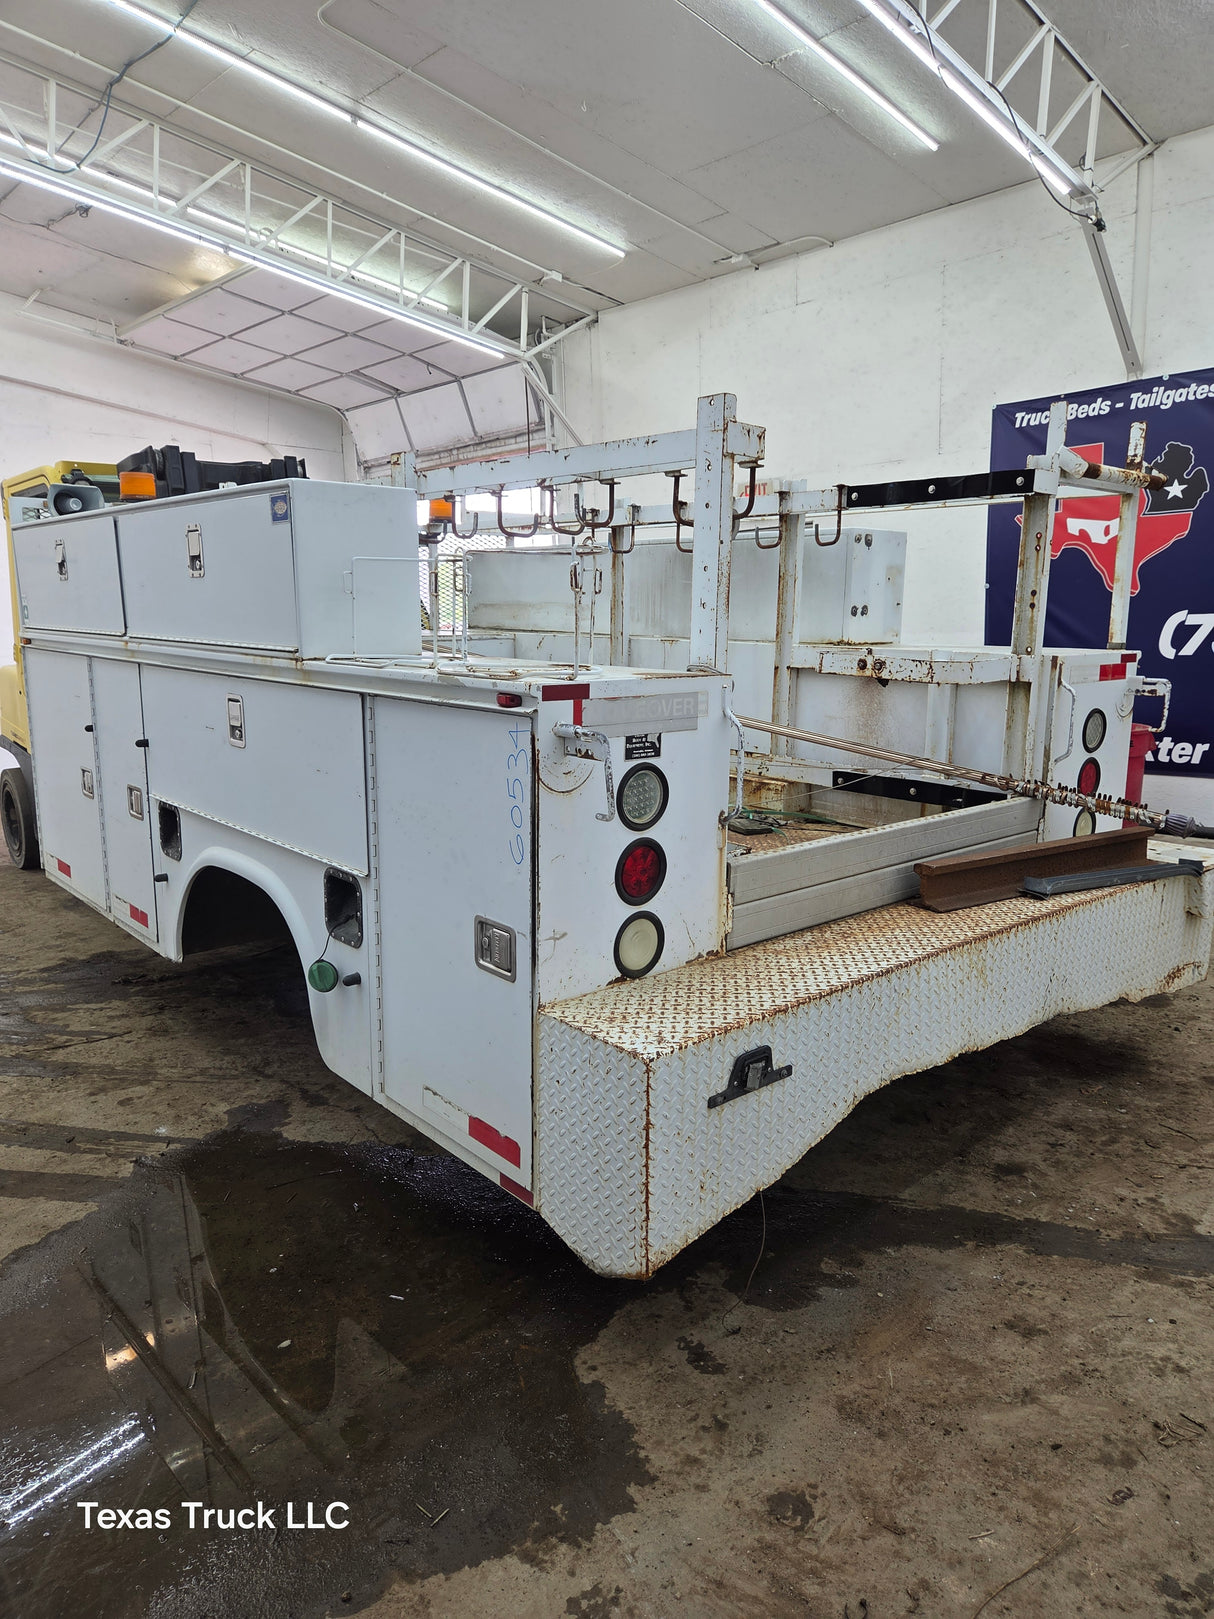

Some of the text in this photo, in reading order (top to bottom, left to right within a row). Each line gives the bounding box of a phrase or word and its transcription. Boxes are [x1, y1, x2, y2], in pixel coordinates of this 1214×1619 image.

[1015, 410, 1051, 428] Truc
[1067, 398, 1111, 420] Beds
[1158, 609, 1214, 660] (7
[506, 721, 531, 866] 60534
